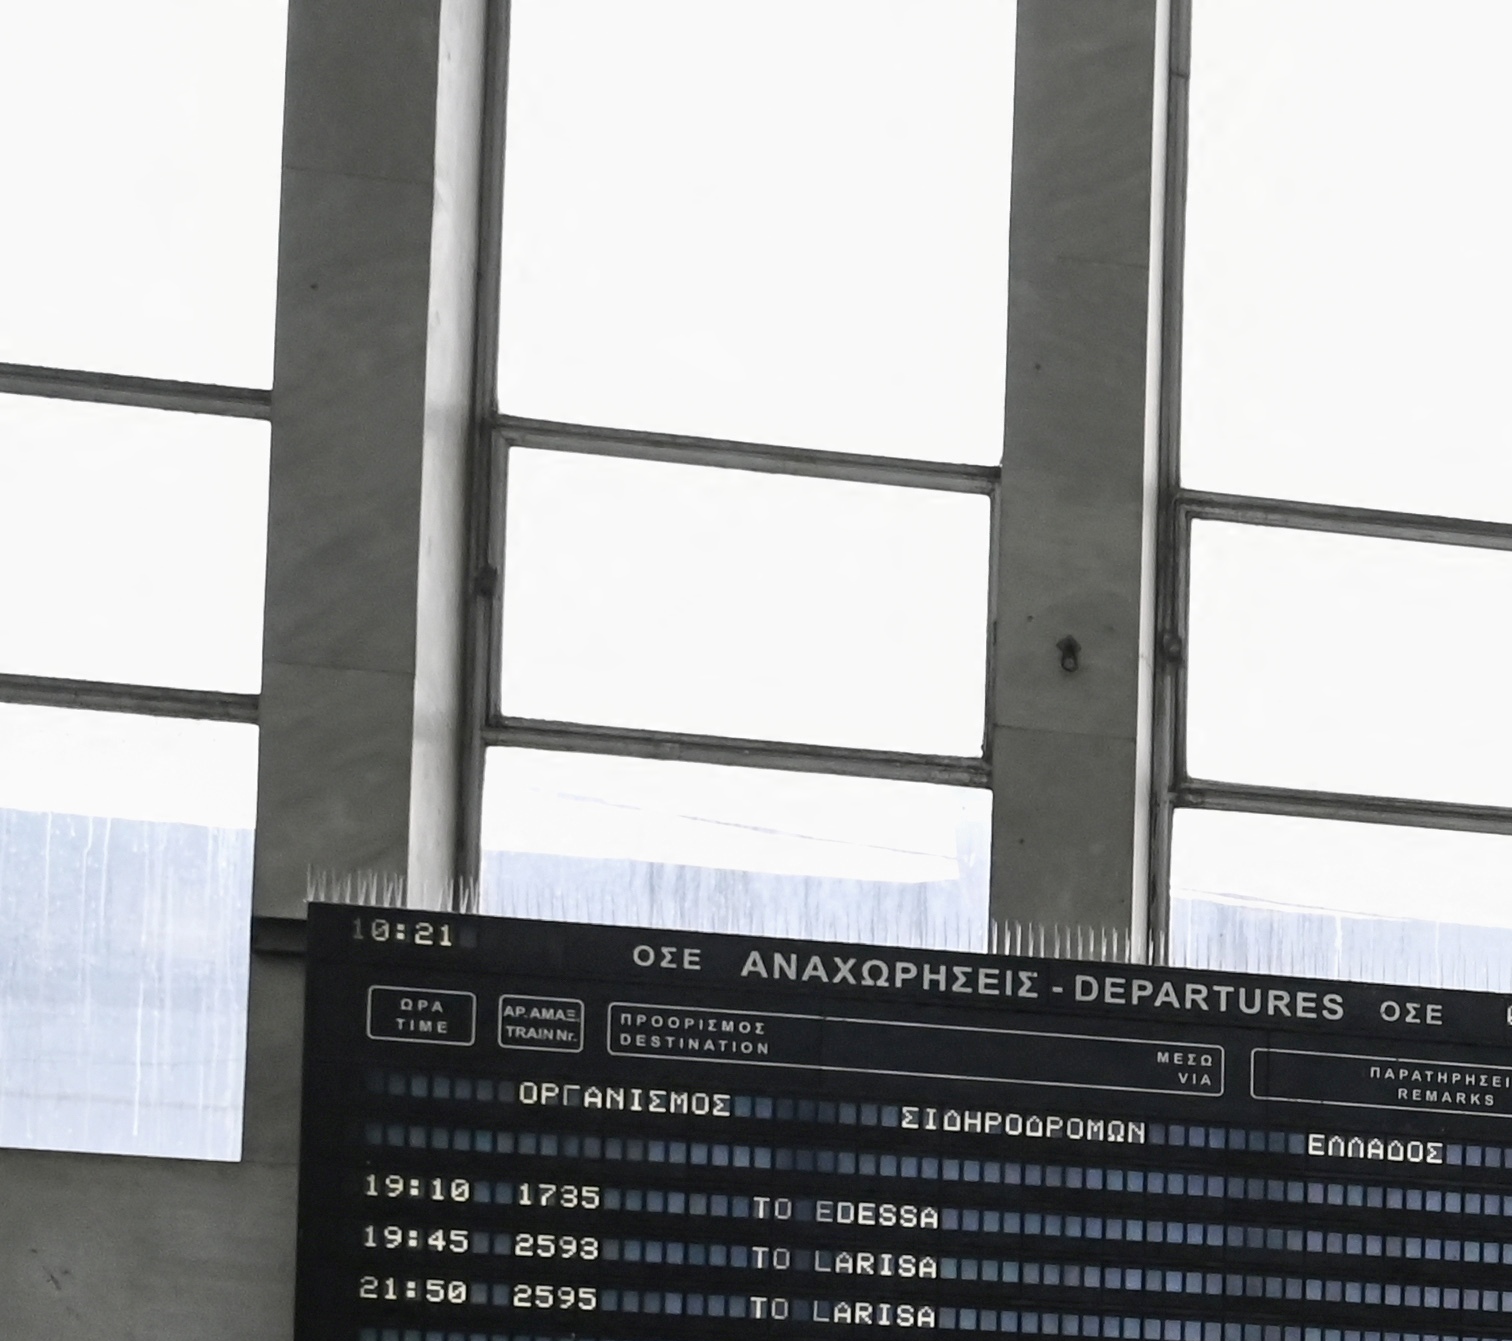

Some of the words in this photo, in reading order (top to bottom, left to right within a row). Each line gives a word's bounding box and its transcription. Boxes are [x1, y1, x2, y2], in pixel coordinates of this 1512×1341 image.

[352, 919, 453, 946] 10:21
[633, 944, 701, 970] ΟΣΕ
[740, 946, 1038, 998] ΑΝΑΧΩΡΗΣΕΙΣ
[1075, 975, 1344, 1020] DEPARTURES
[1379, 1000, 1443, 1025] ΟΣΕ
[400, 998, 443, 1013] ΩΡΑ
[396, 1017, 447, 1034] TIME
[505, 1025, 554, 1040] TRAIN
[620, 1013, 765, 1035] ΠΡΟΟΡΙΣΜΟΣ
[620, 1033, 768, 1055] DESTINATION
[1157, 1051, 1212, 1067] ΜΕΣΩ
[1178, 1072, 1211, 1086] VIA
[1397, 1087, 1494, 1106] REMARKS
[519, 1081, 731, 1117] ΟΡΓΑΝΙΣΜΟΣ
[901, 1106, 1145, 1144] ΣΙΔΗΡΟΔΡΟΜΩΝ
[1308, 1133, 1443, 1164] ΕΛΛΑΔΟΣ
[366, 1174, 470, 1202] 19:10
[519, 1183, 600, 1209] 1735
[753, 1196, 792, 1220] TO
[816, 1201, 938, 1229] EDESSA
[365, 1226, 469, 1253] 19:45
[514, 1233, 599, 1260] 2593
[752, 1246, 790, 1270] TO
[815, 1251, 937, 1279] LARISA
[360, 1276, 467, 1304] 21:50
[513, 1284, 597, 1311] 2595
[750, 1296, 789, 1320] TO
[813, 1300, 935, 1328] LARISA
